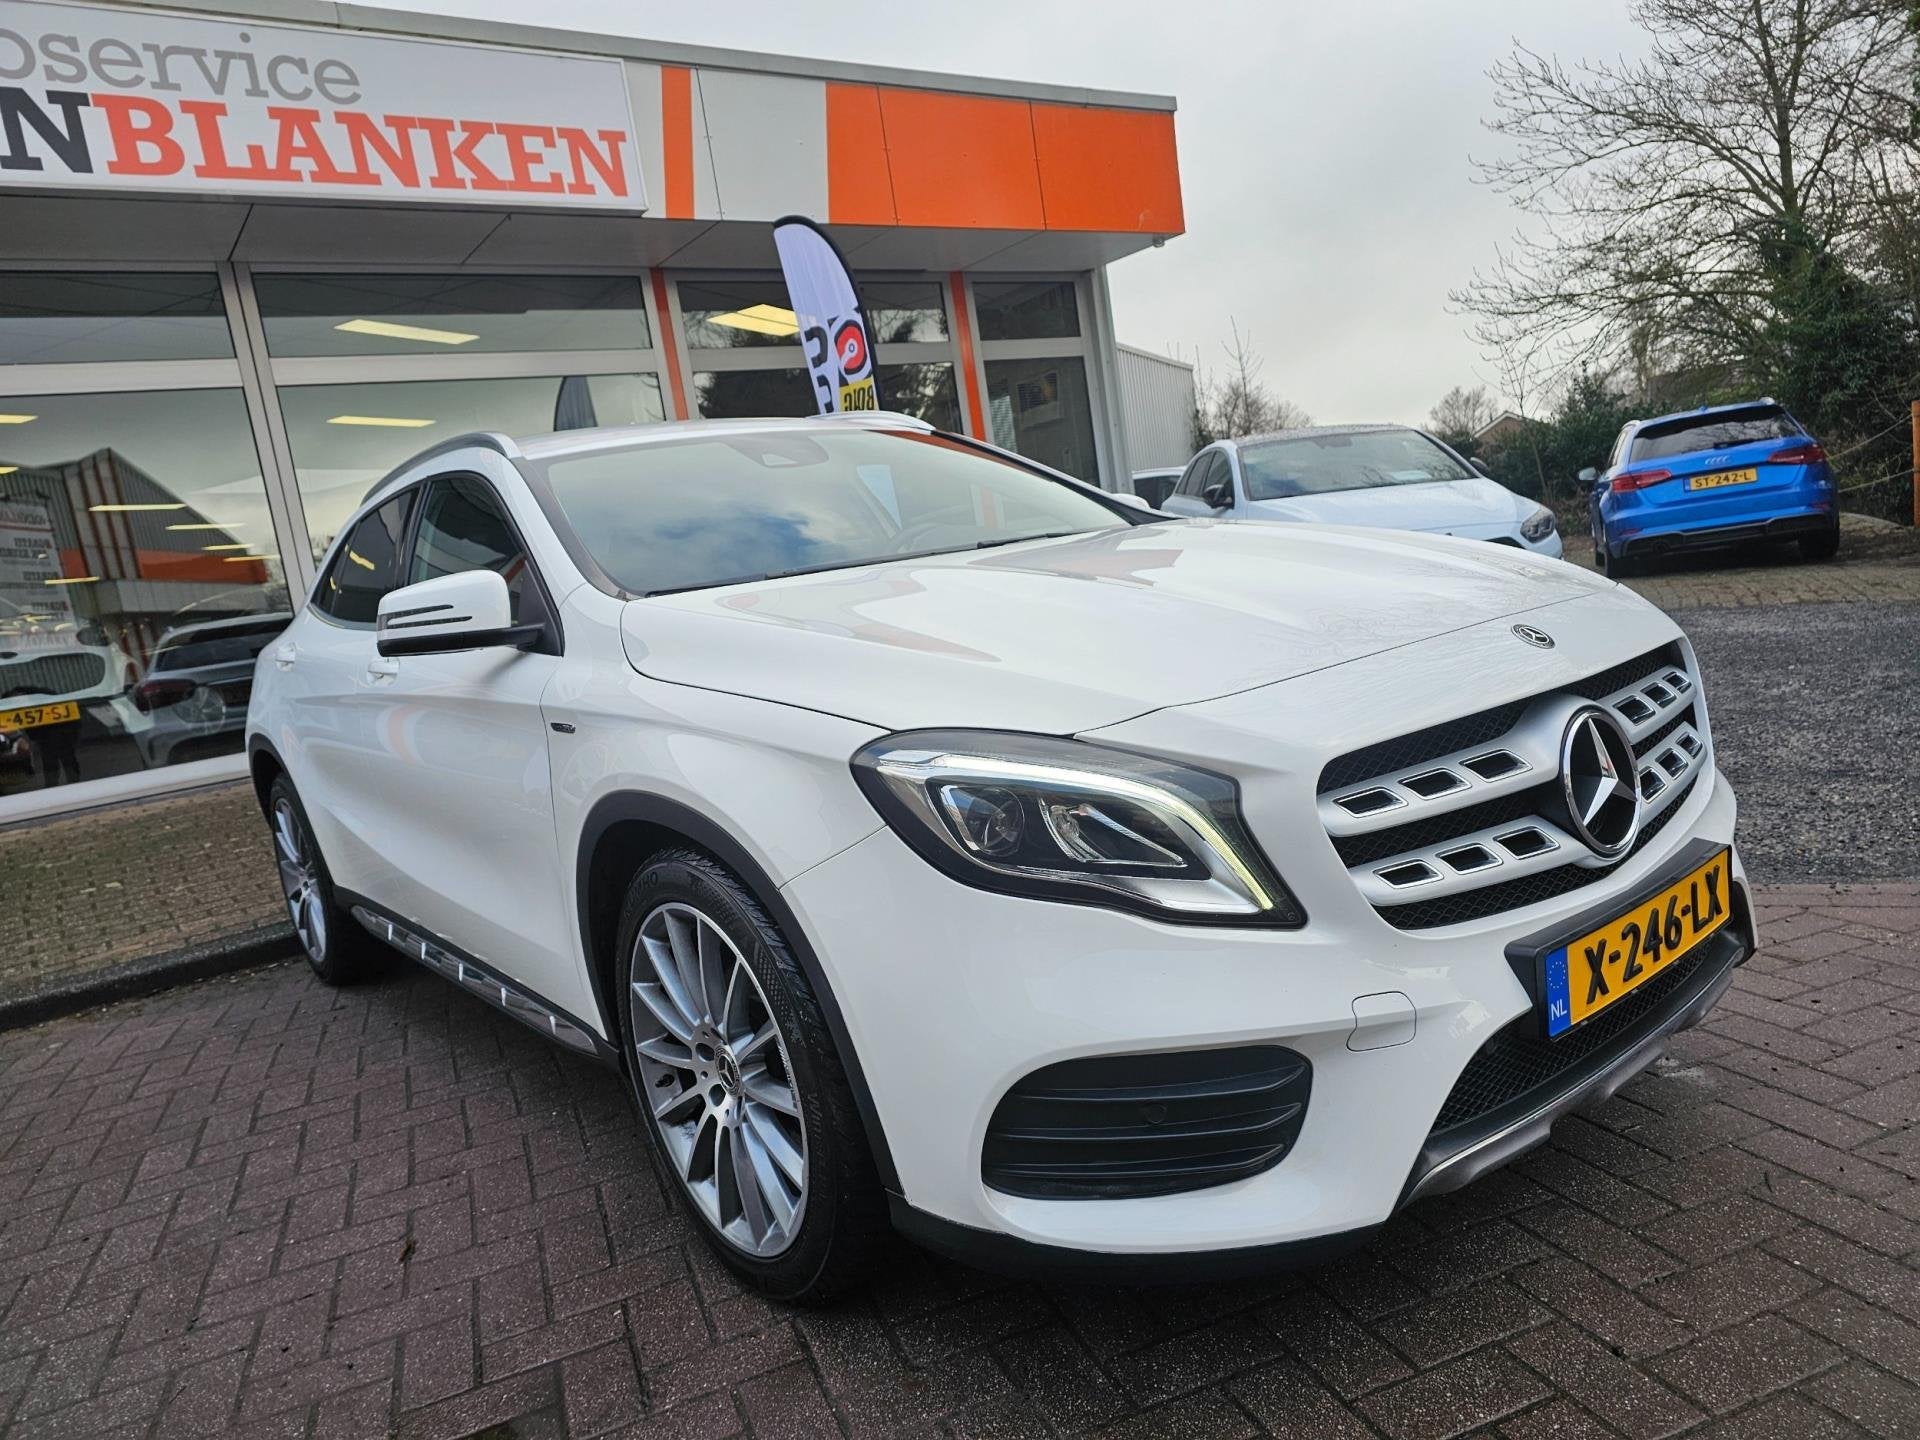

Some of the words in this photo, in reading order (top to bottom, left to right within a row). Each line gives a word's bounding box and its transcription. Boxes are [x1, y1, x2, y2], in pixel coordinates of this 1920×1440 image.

[0, 27, 362, 105] oservice
[1695, 471, 1752, 488] ST-242-L
[1584, 864, 1722, 1005] X-246-LX
[1550, 998, 1568, 1021] NL
